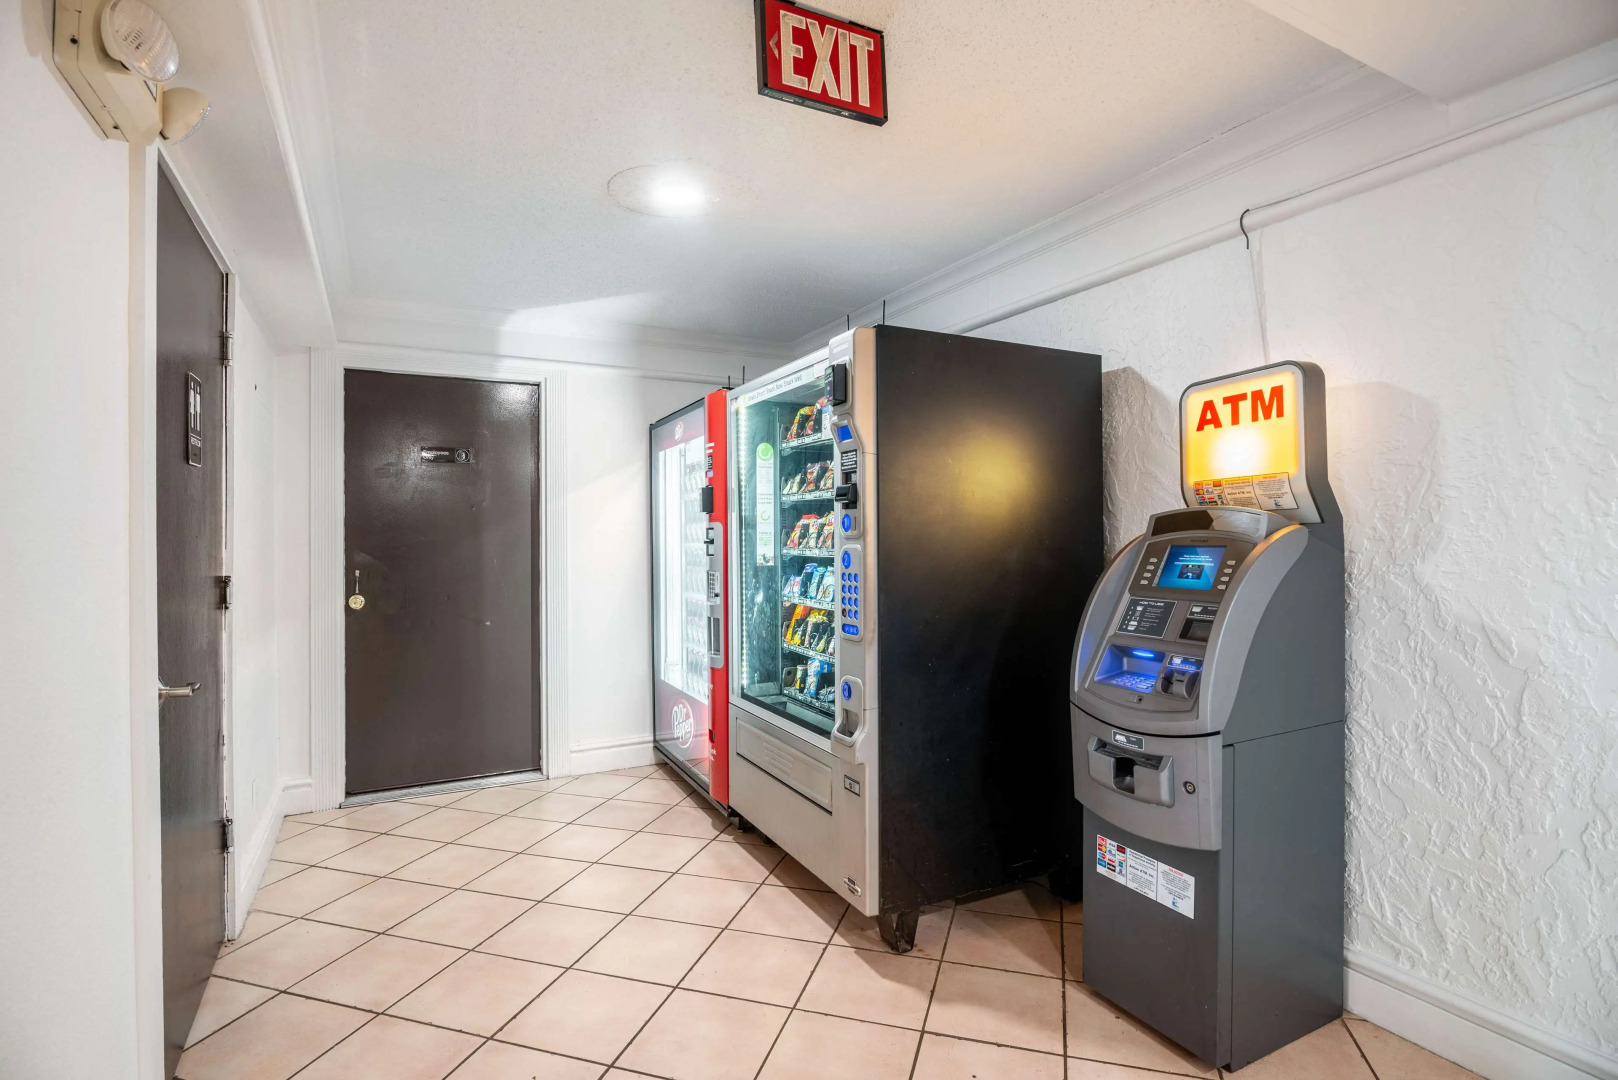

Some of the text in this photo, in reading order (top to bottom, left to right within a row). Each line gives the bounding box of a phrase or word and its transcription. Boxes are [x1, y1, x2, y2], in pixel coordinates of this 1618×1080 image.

[779, 9, 875, 108] EXIT
[1196, 384, 1284, 432] ATM
[672, 705, 694, 742] Pepper
